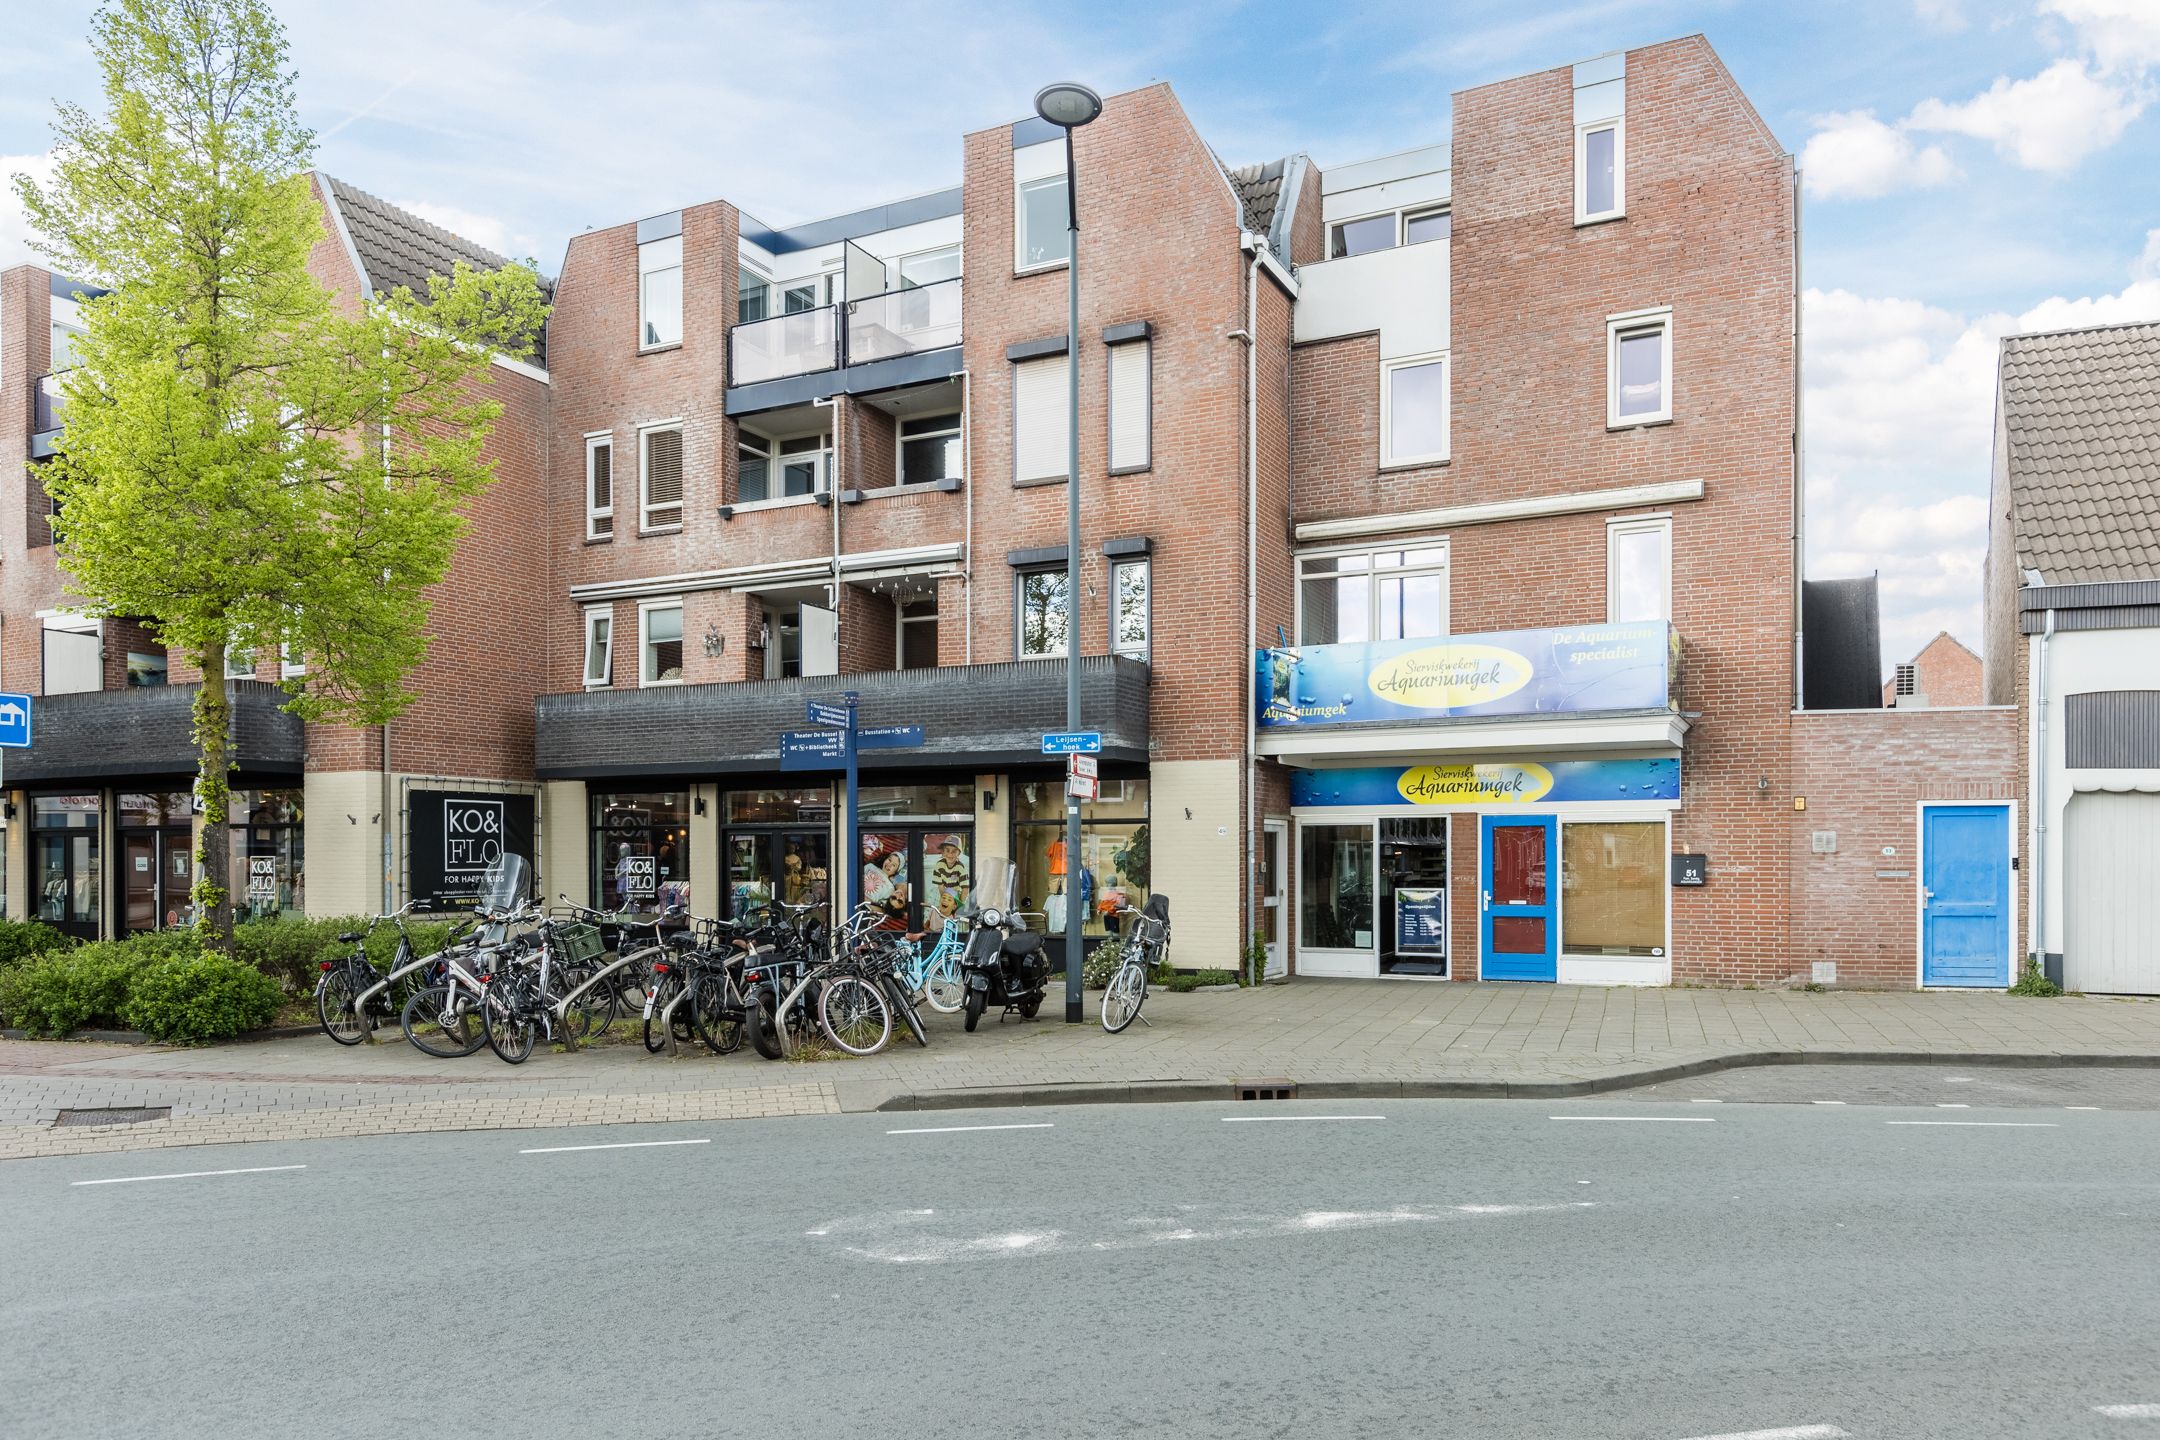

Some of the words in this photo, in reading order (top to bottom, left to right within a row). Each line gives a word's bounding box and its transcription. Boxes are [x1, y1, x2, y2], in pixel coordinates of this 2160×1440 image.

[1553, 631, 1572, 645] De
[1569, 647, 1638, 664] specialist
[1405, 657, 1480, 675] Sierviskwekerij
[1377, 663, 1500, 695] Aquariumgek
[1432, 766, 1504, 780] Sierviskwekerij
[1406, 772, 1523, 799] Aquariumgek
[449, 809, 500, 834] KO&
[449, 839, 501, 865] FLO
[251, 860, 274, 874] KO&
[628, 861, 653, 874] KO&
[251, 876, 274, 890] FLO
[444, 875, 459, 884] FOR
[486, 875, 505, 883] KIDS
[628, 875, 653, 889] FLO
